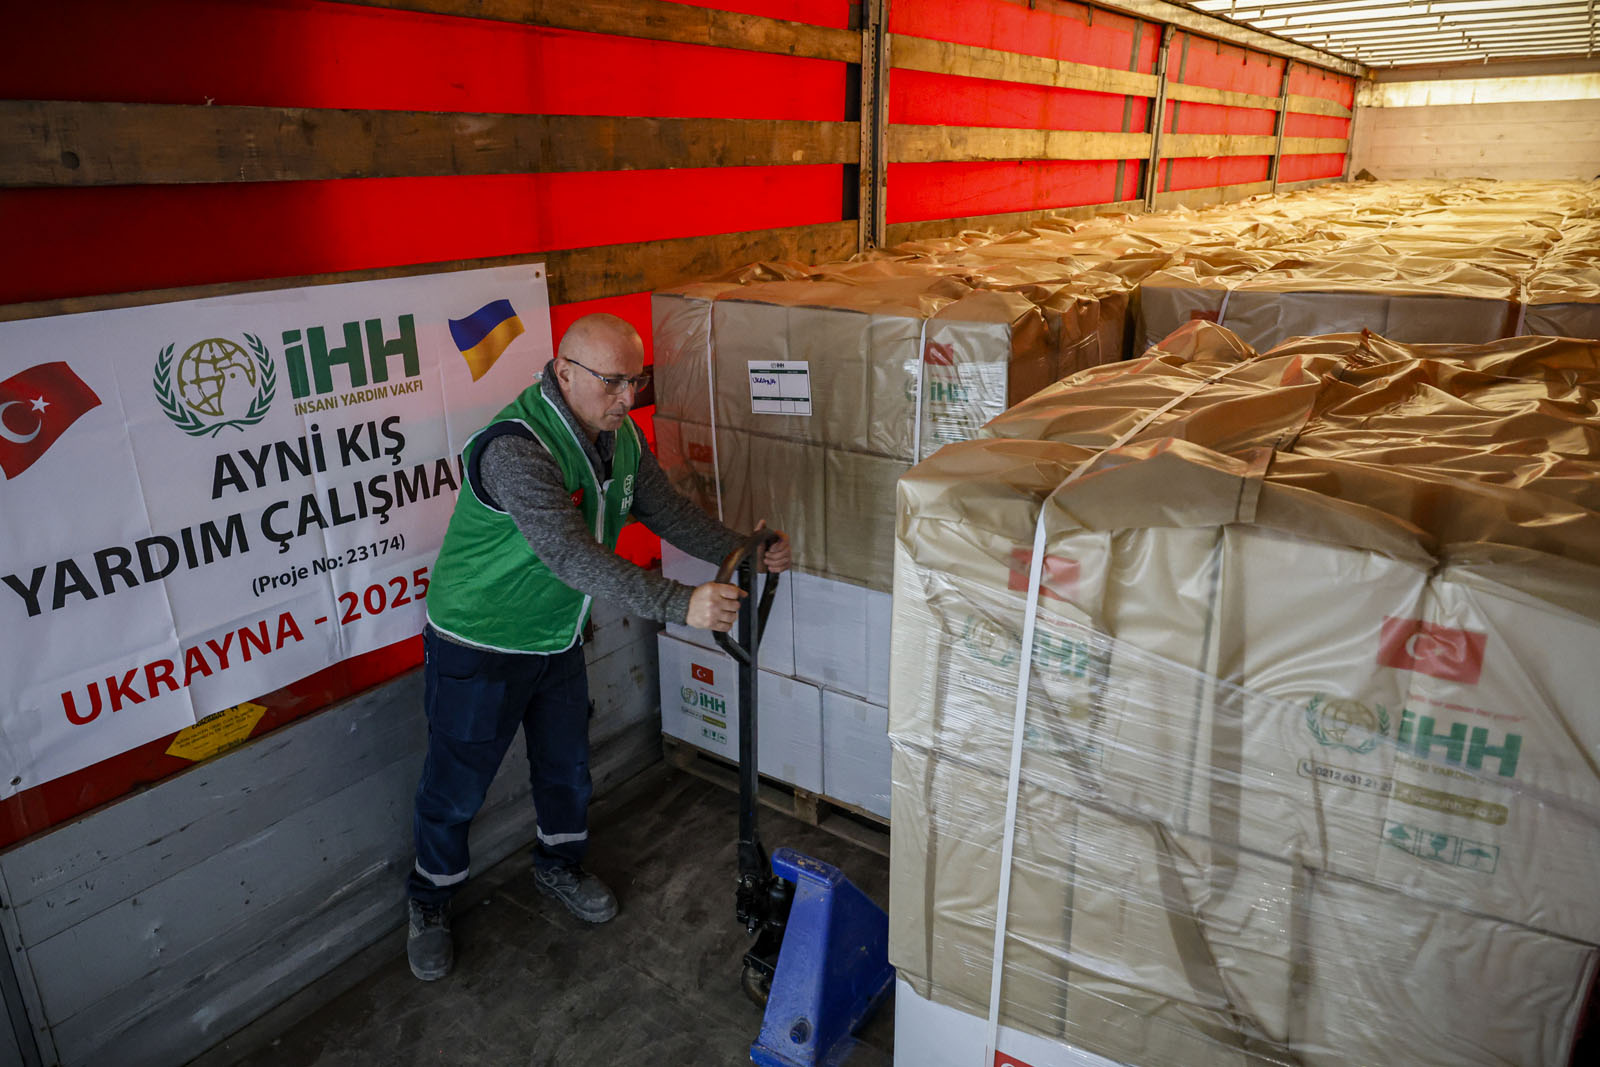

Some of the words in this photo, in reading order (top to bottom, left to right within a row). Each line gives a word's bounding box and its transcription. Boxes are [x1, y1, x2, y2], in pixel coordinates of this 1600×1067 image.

[340, 386, 388, 407] YARDIM
[389, 379, 423, 397] VAKFI
[212, 423, 327, 500] AYNİ
[336, 415, 406, 467] KIŞ
[1, 513, 251, 619] YARDIM
[252, 566, 309, 598] (Proje
[312, 554, 344, 577] No:
[346, 533, 406, 566] 23174)
[60, 611, 305, 726] UKRAYNA
[337, 566, 431, 626] 2025
